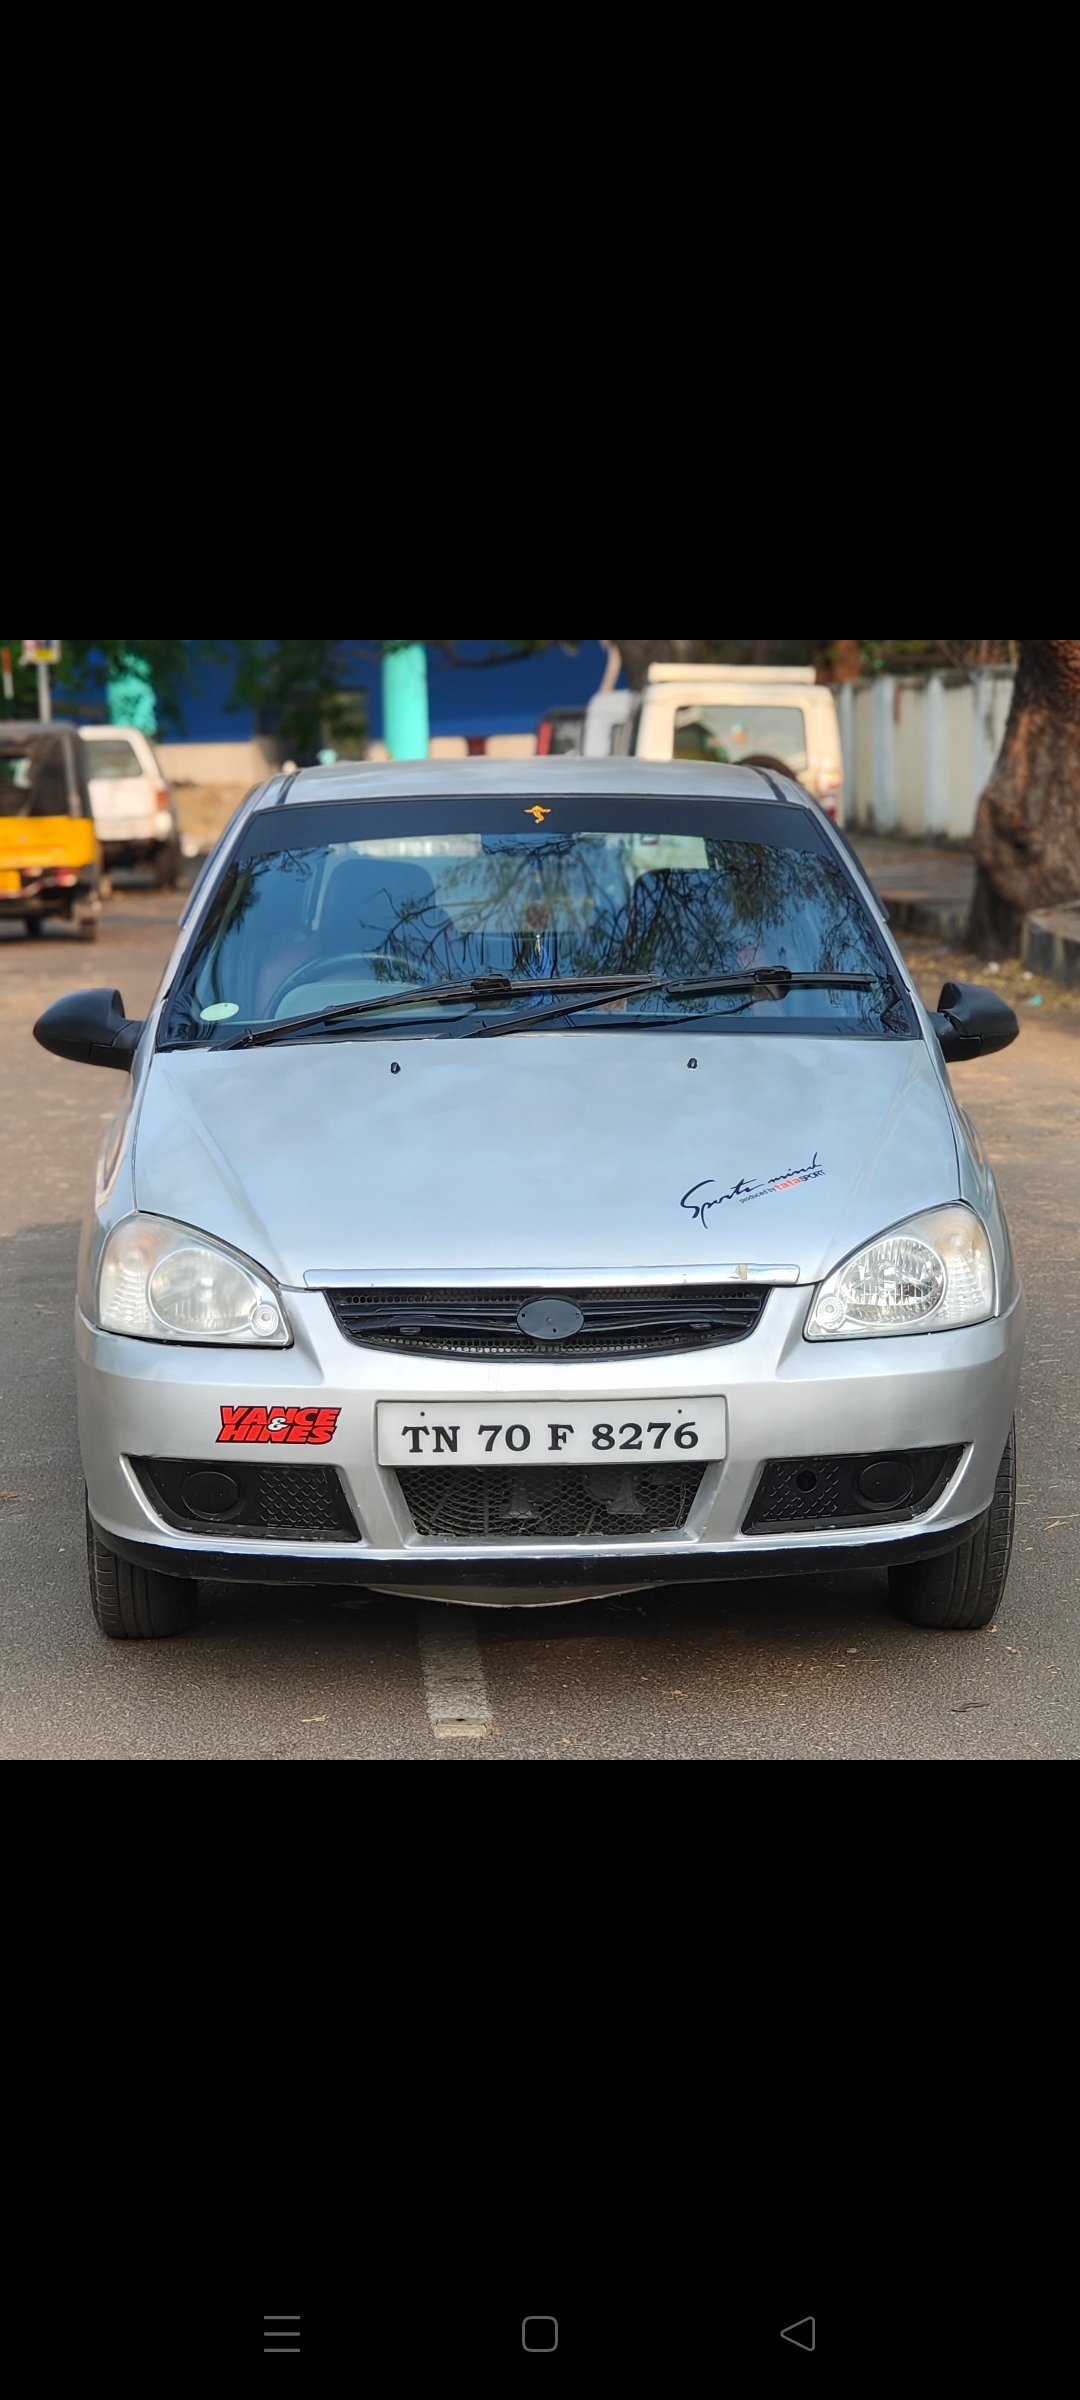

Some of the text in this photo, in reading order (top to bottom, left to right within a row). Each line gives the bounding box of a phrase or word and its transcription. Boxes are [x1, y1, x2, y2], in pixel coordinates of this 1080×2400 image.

[680, 1151, 822, 1229] Sports mind
[220, 1406, 341, 1427] VANCE
[267, 1416, 289, 1431] &
[215, 1424, 337, 1445] HINES
[401, 1421, 699, 1453] TN 70 F 8276
